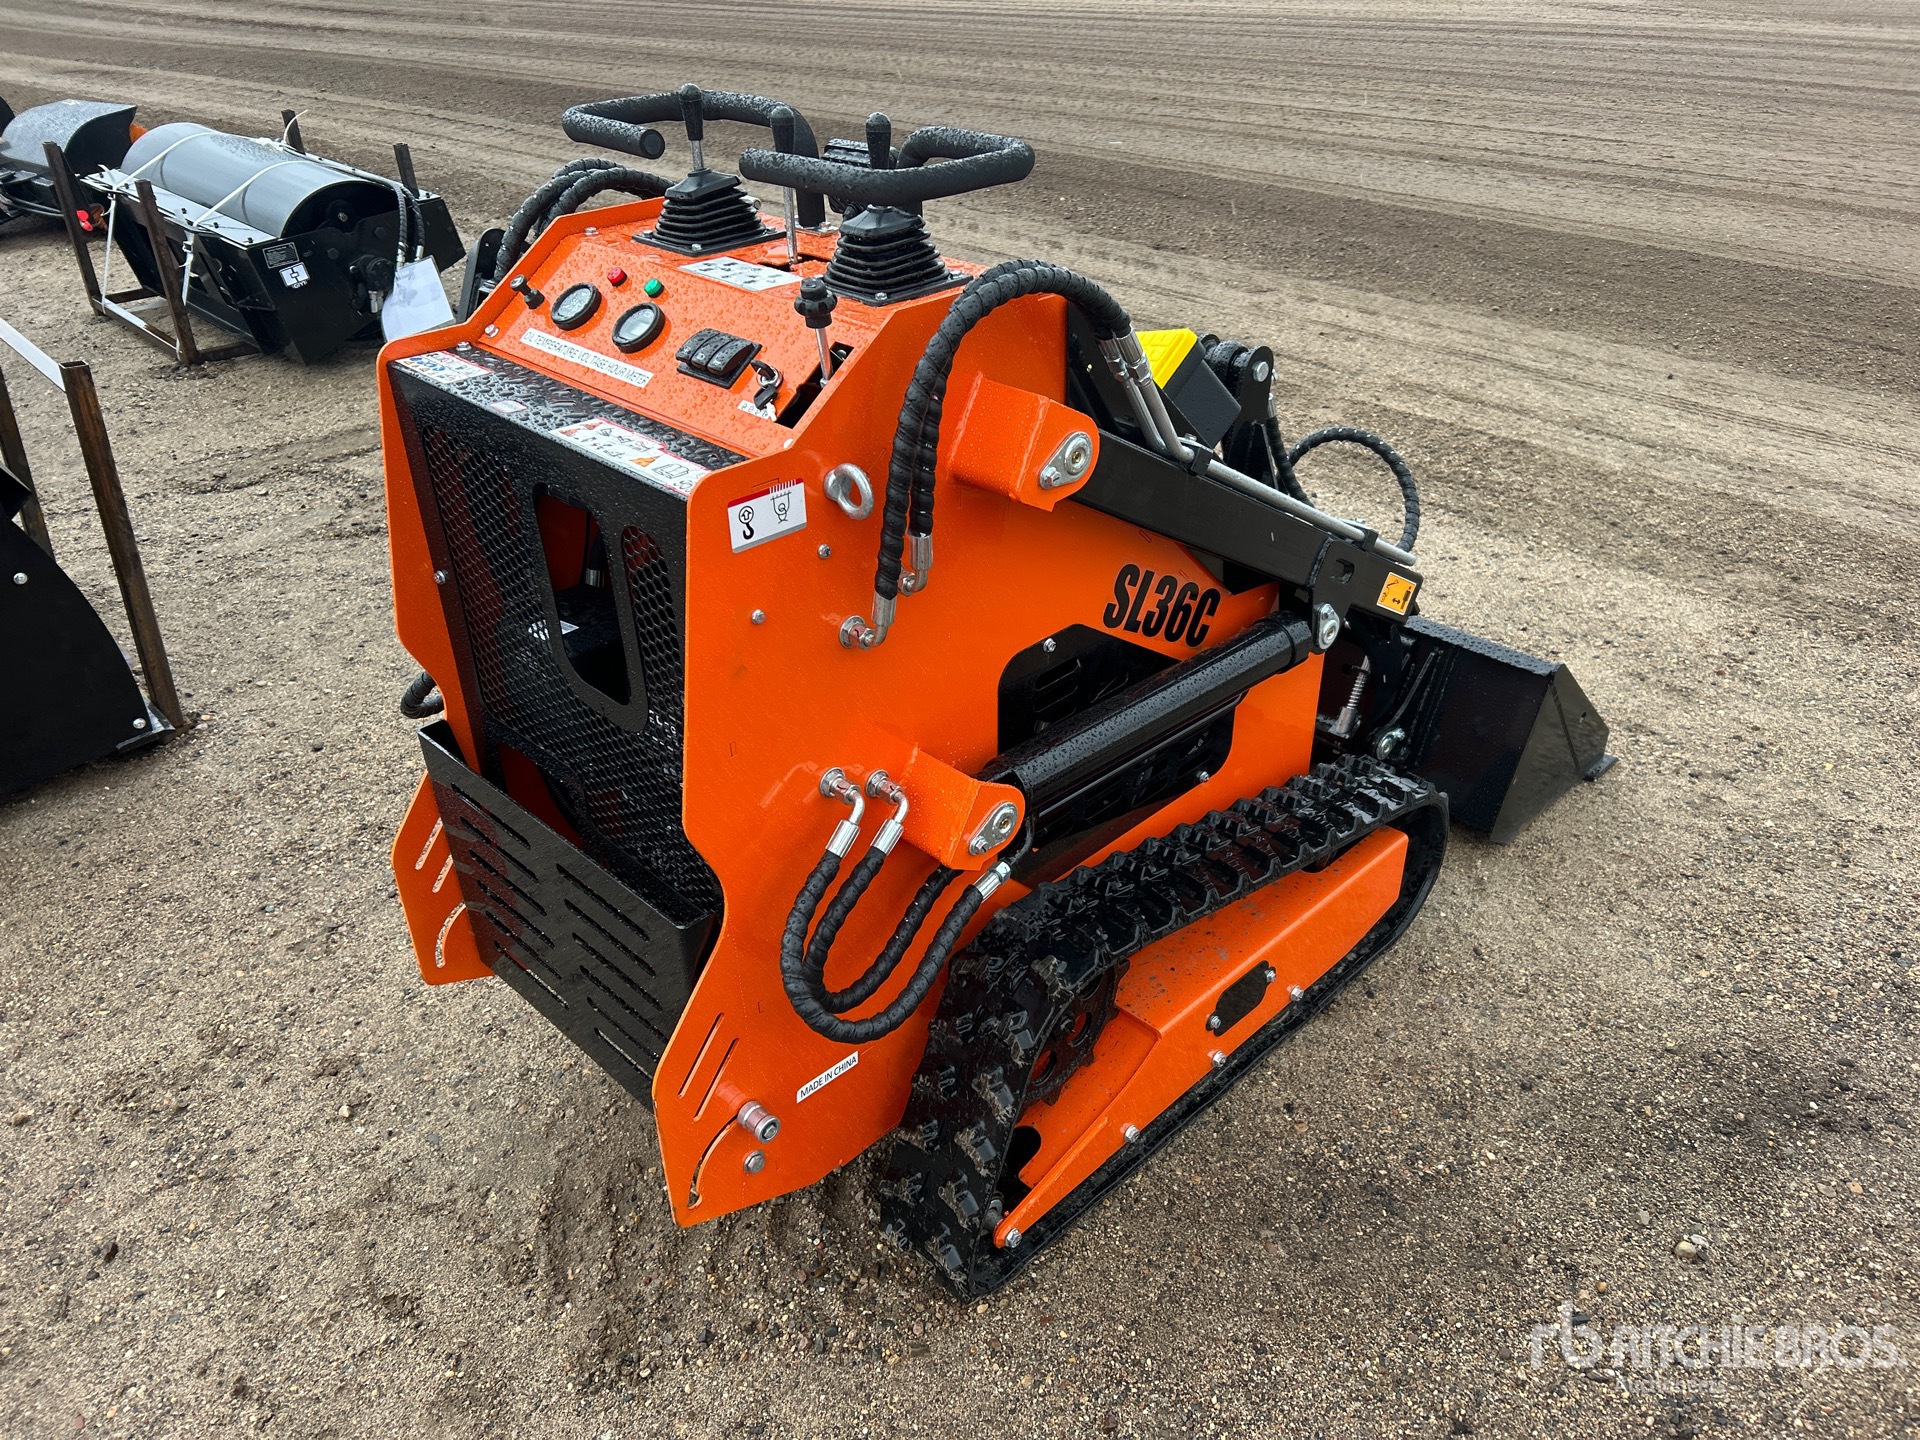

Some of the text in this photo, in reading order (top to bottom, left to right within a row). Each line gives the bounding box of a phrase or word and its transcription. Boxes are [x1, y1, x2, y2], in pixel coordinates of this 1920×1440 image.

[534, 335, 579, 358] TEMPERATURE
[577, 351, 609, 369] VOLTAGE
[606, 362, 627, 376] HOUR
[624, 369, 650, 385] METER
[1103, 563, 1221, 647] SL36C
[800, 1056, 857, 1098] MADE IN CHINA
